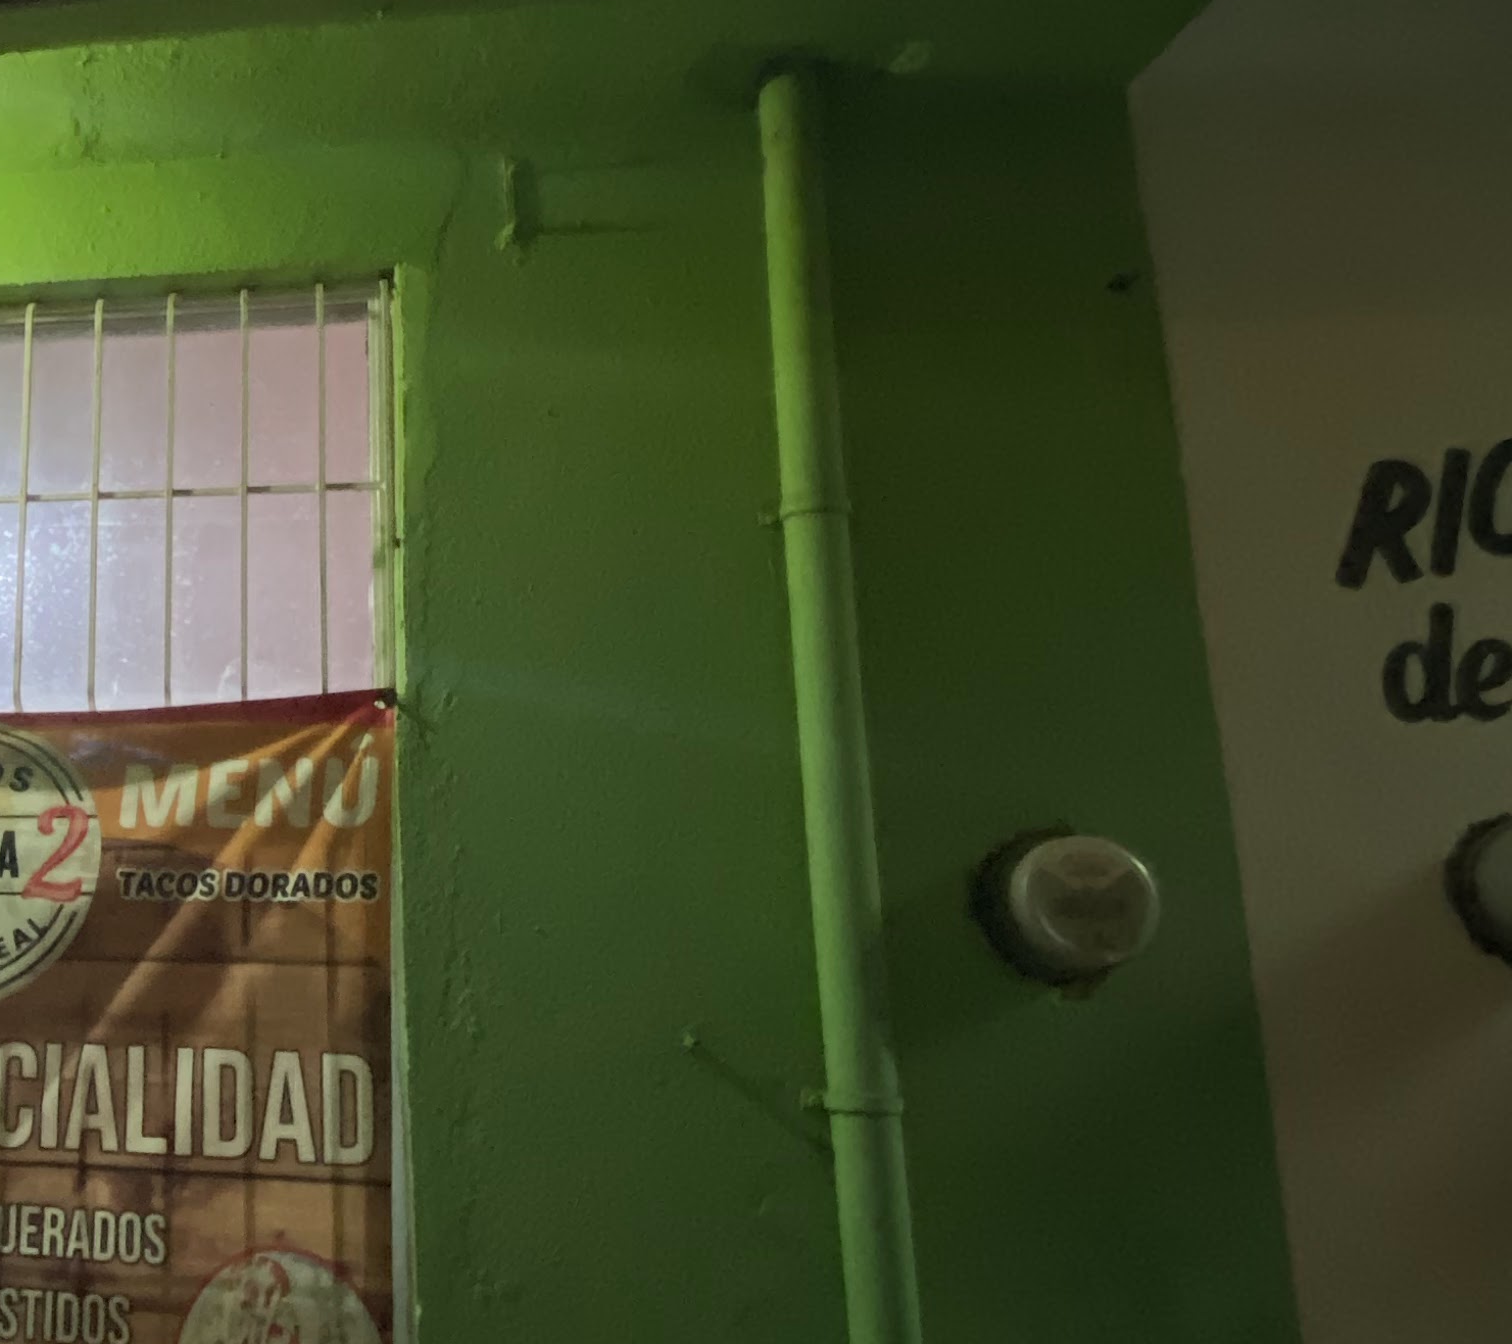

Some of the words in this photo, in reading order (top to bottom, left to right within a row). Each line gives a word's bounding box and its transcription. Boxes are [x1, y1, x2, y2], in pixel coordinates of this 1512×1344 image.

[20, 806, 89, 902] 2
[117, 869, 219, 900] TACOS
[224, 868, 380, 901] DORADOS
